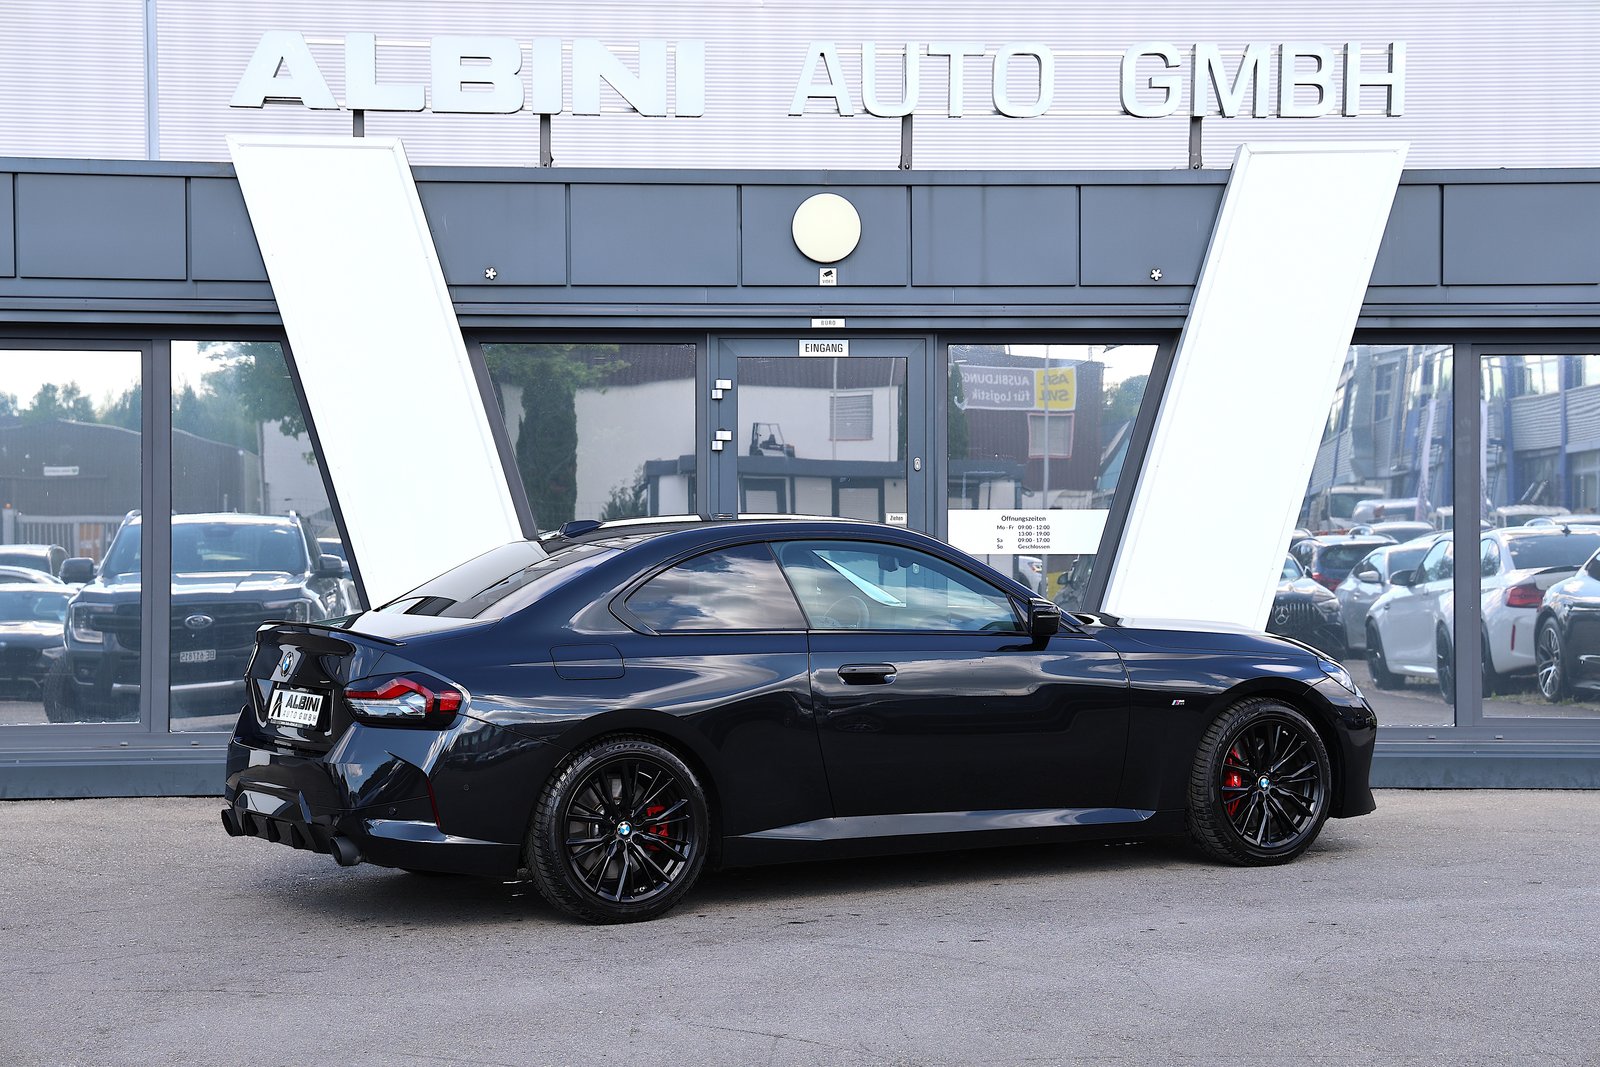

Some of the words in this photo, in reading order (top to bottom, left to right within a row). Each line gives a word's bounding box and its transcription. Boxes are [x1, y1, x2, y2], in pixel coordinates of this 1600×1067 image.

[228, 30, 705, 118] ALBINI
[787, 41, 1055, 118] AUTO
[1119, 41, 1406, 118] GMBH
[805, 344, 843, 353] EINGANG
[285, 694, 320, 712] ALBINI
